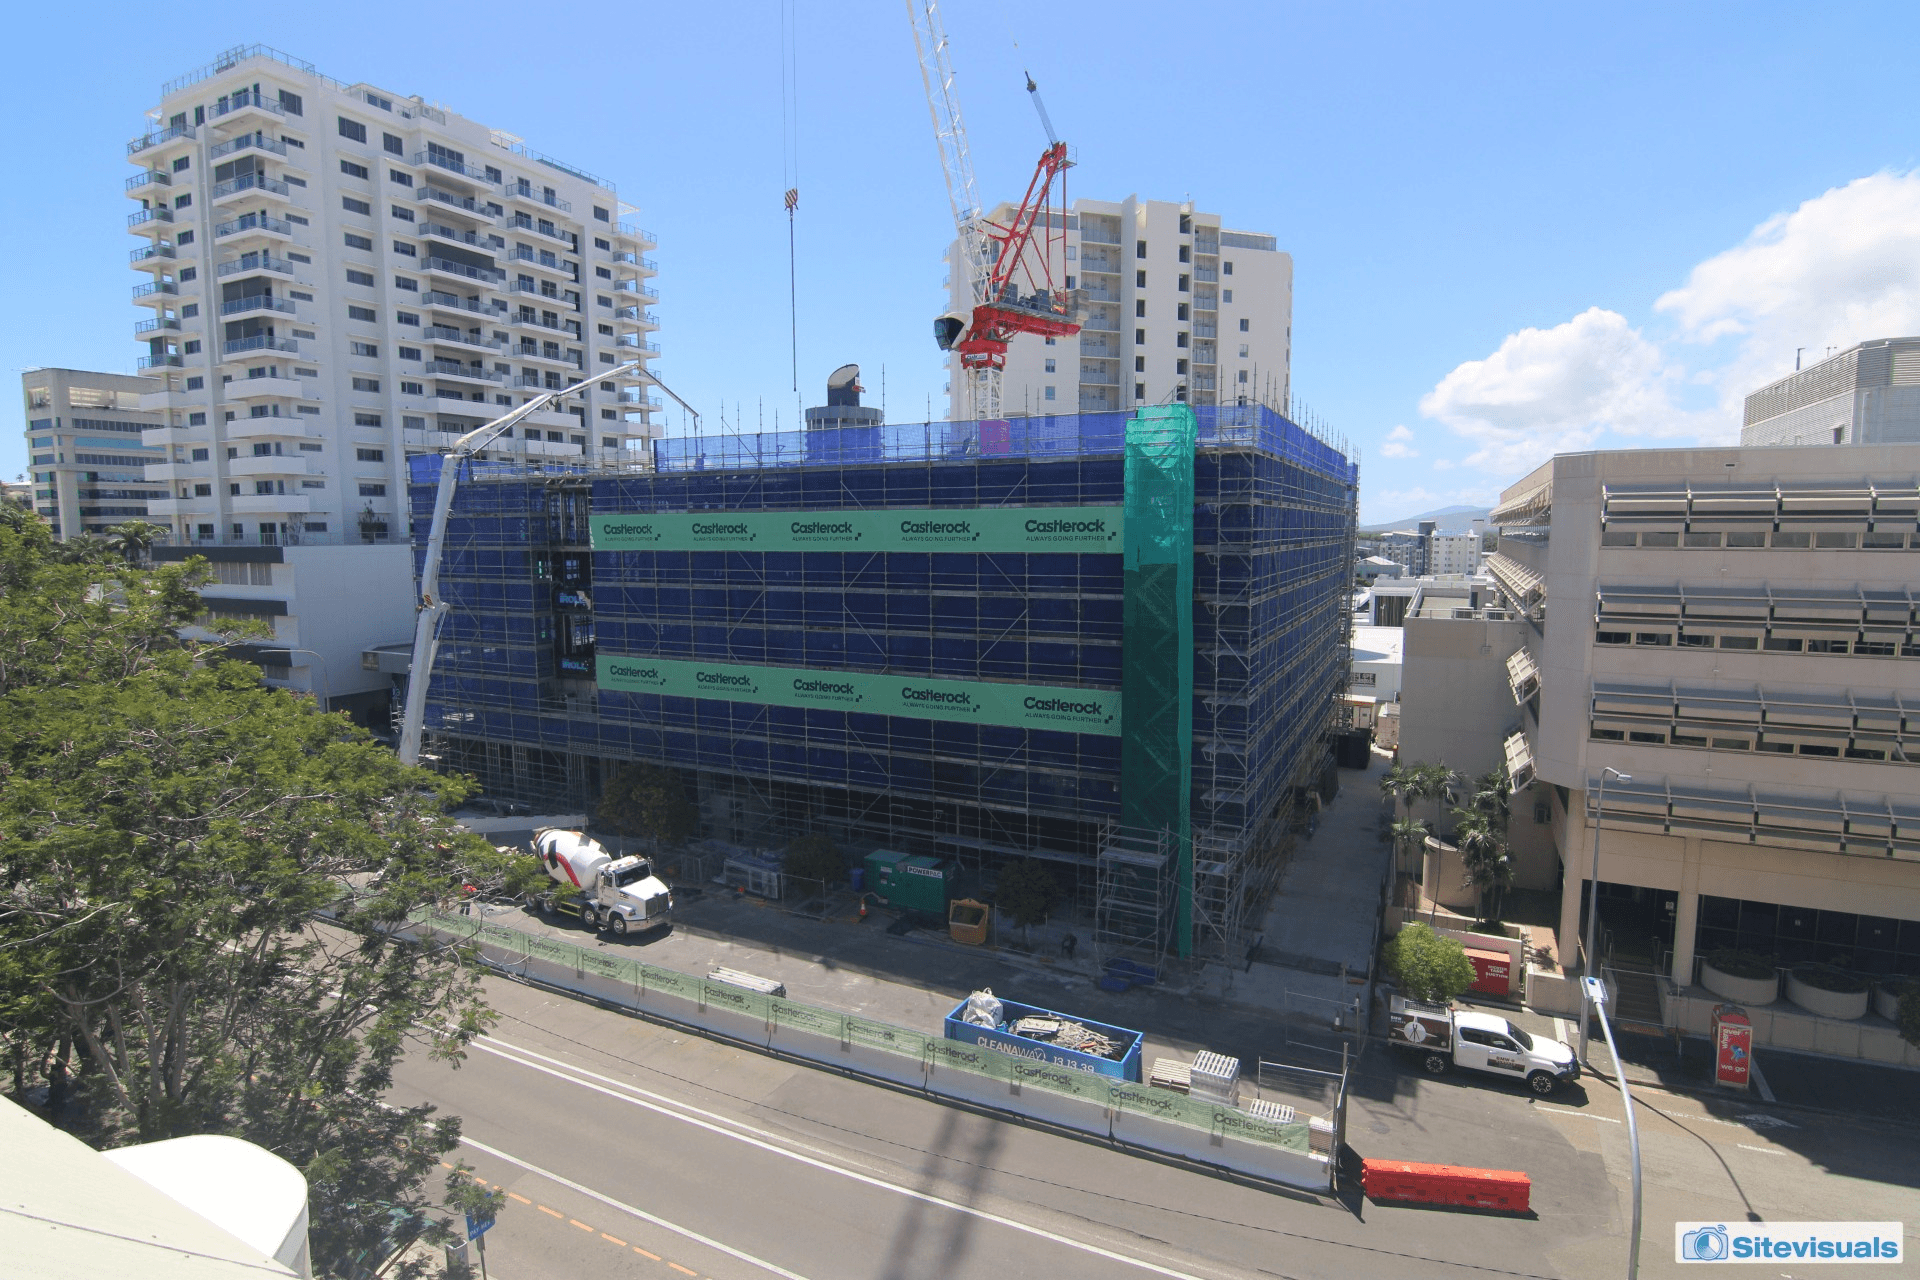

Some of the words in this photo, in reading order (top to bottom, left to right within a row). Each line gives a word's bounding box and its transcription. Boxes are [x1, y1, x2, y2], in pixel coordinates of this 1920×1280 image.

[603, 524, 652, 535] Castlerock
[692, 523, 748, 535] Castlerock
[791, 522, 853, 534] Castlerock
[901, 521, 970, 533] Castlerock
[1025, 519, 1105, 532] Castlerock
[610, 665, 659, 679] Castlerock
[696, 672, 750, 686] Castlerock
[793, 678, 854, 695] Castlerock
[902, 687, 971, 704] Castlerock
[1024, 696, 1102, 715] Castlerock
[1073, 715, 1102, 724] FURTHER
[641, 970, 679, 987] Castlerock
[704, 986, 744, 1004] Castlerock
[926, 1042, 980, 1064] Castlerock
[977, 1036, 1043, 1061] CLEANAWAY
[1053, 1056, 1064, 1066] 13
[1067, 1059, 1077, 1070] 13
[1081, 1063, 1095, 1073] 39
[1014, 1065, 1072, 1086] Castlerock
[1110, 1087, 1172, 1110] Castlerock
[1213, 1112, 1282, 1138] Castlerock
